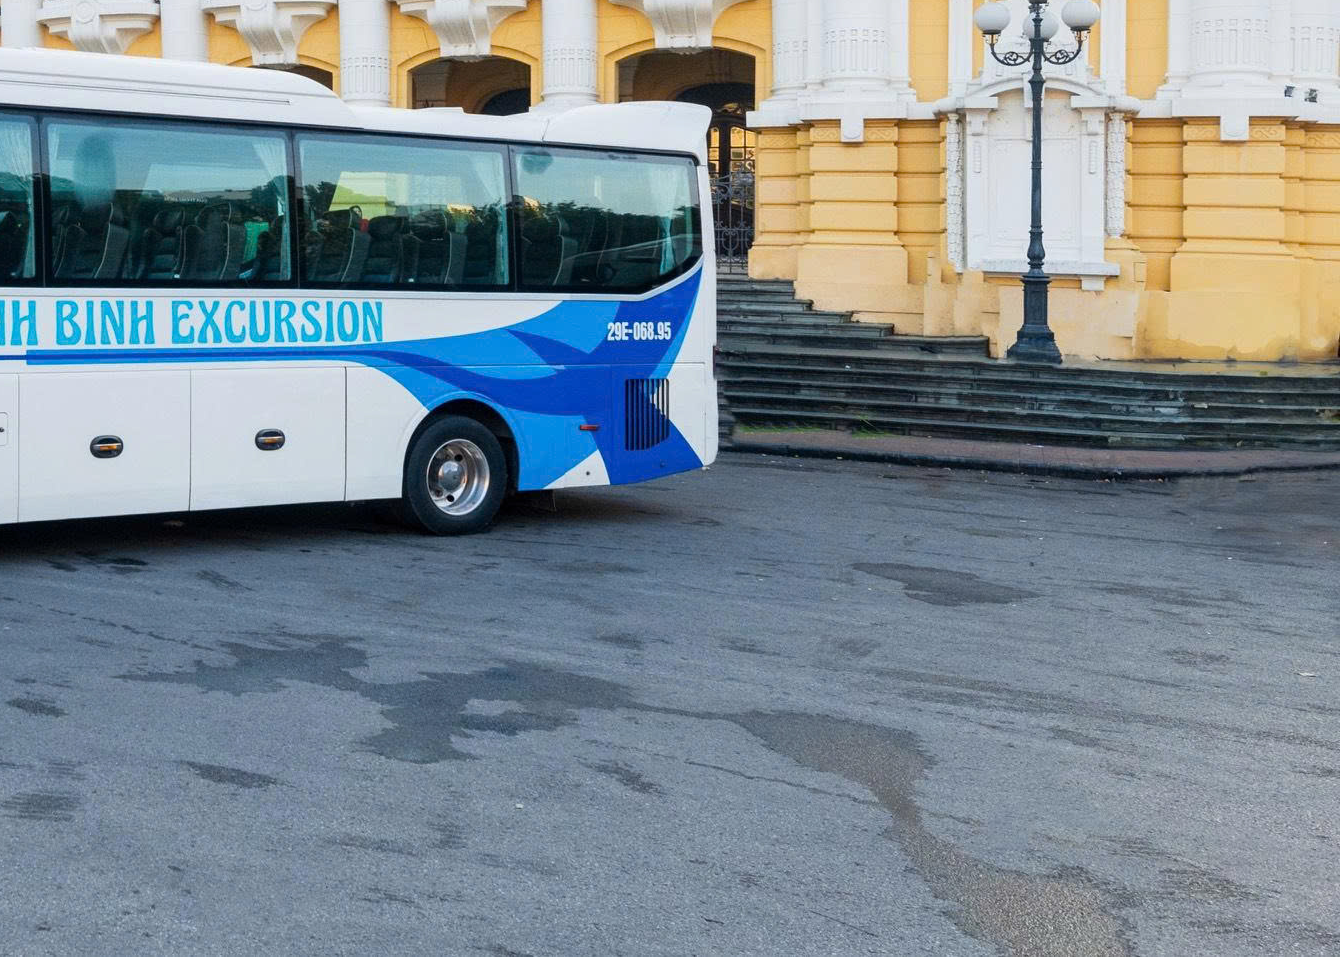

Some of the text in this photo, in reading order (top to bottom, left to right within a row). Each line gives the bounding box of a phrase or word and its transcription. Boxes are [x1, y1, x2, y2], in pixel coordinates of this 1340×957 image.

[55, 299, 156, 346] BINH
[170, 299, 385, 344] EXCURSION
[607, 321, 672, 341] 29E-068.95
